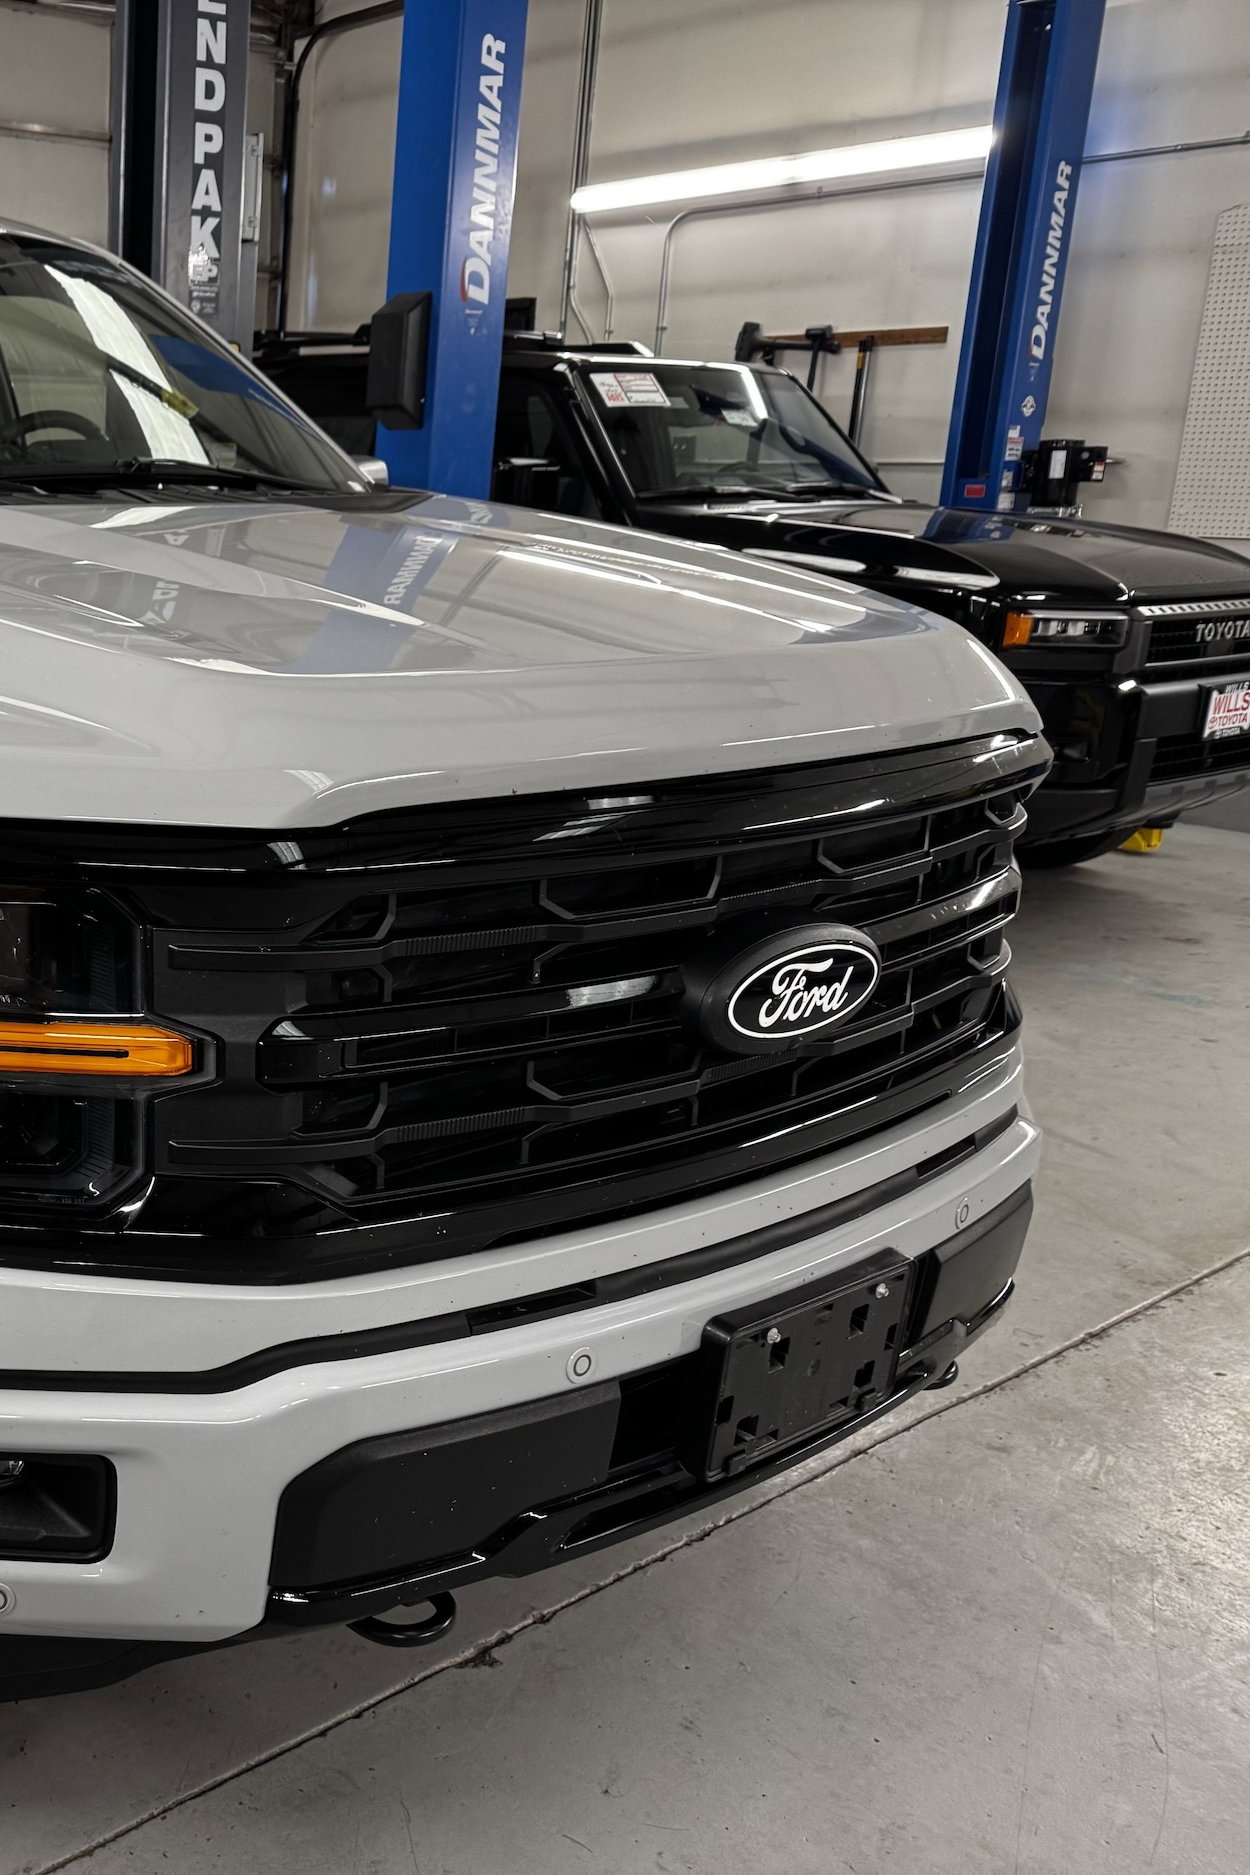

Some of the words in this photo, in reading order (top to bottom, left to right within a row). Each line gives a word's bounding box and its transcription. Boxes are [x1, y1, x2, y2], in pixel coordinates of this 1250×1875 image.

[462, 33, 506, 304] DANNMAR
[1030, 160, 1072, 361] DANNMAR
[1195, 620, 1250, 643] TOYOTA
[1225, 681, 1249, 693] WILLS
[1213, 691, 1250, 715] WILLS
[1217, 712, 1248, 727] TOYOTA
[759, 957, 854, 1028] Ford
